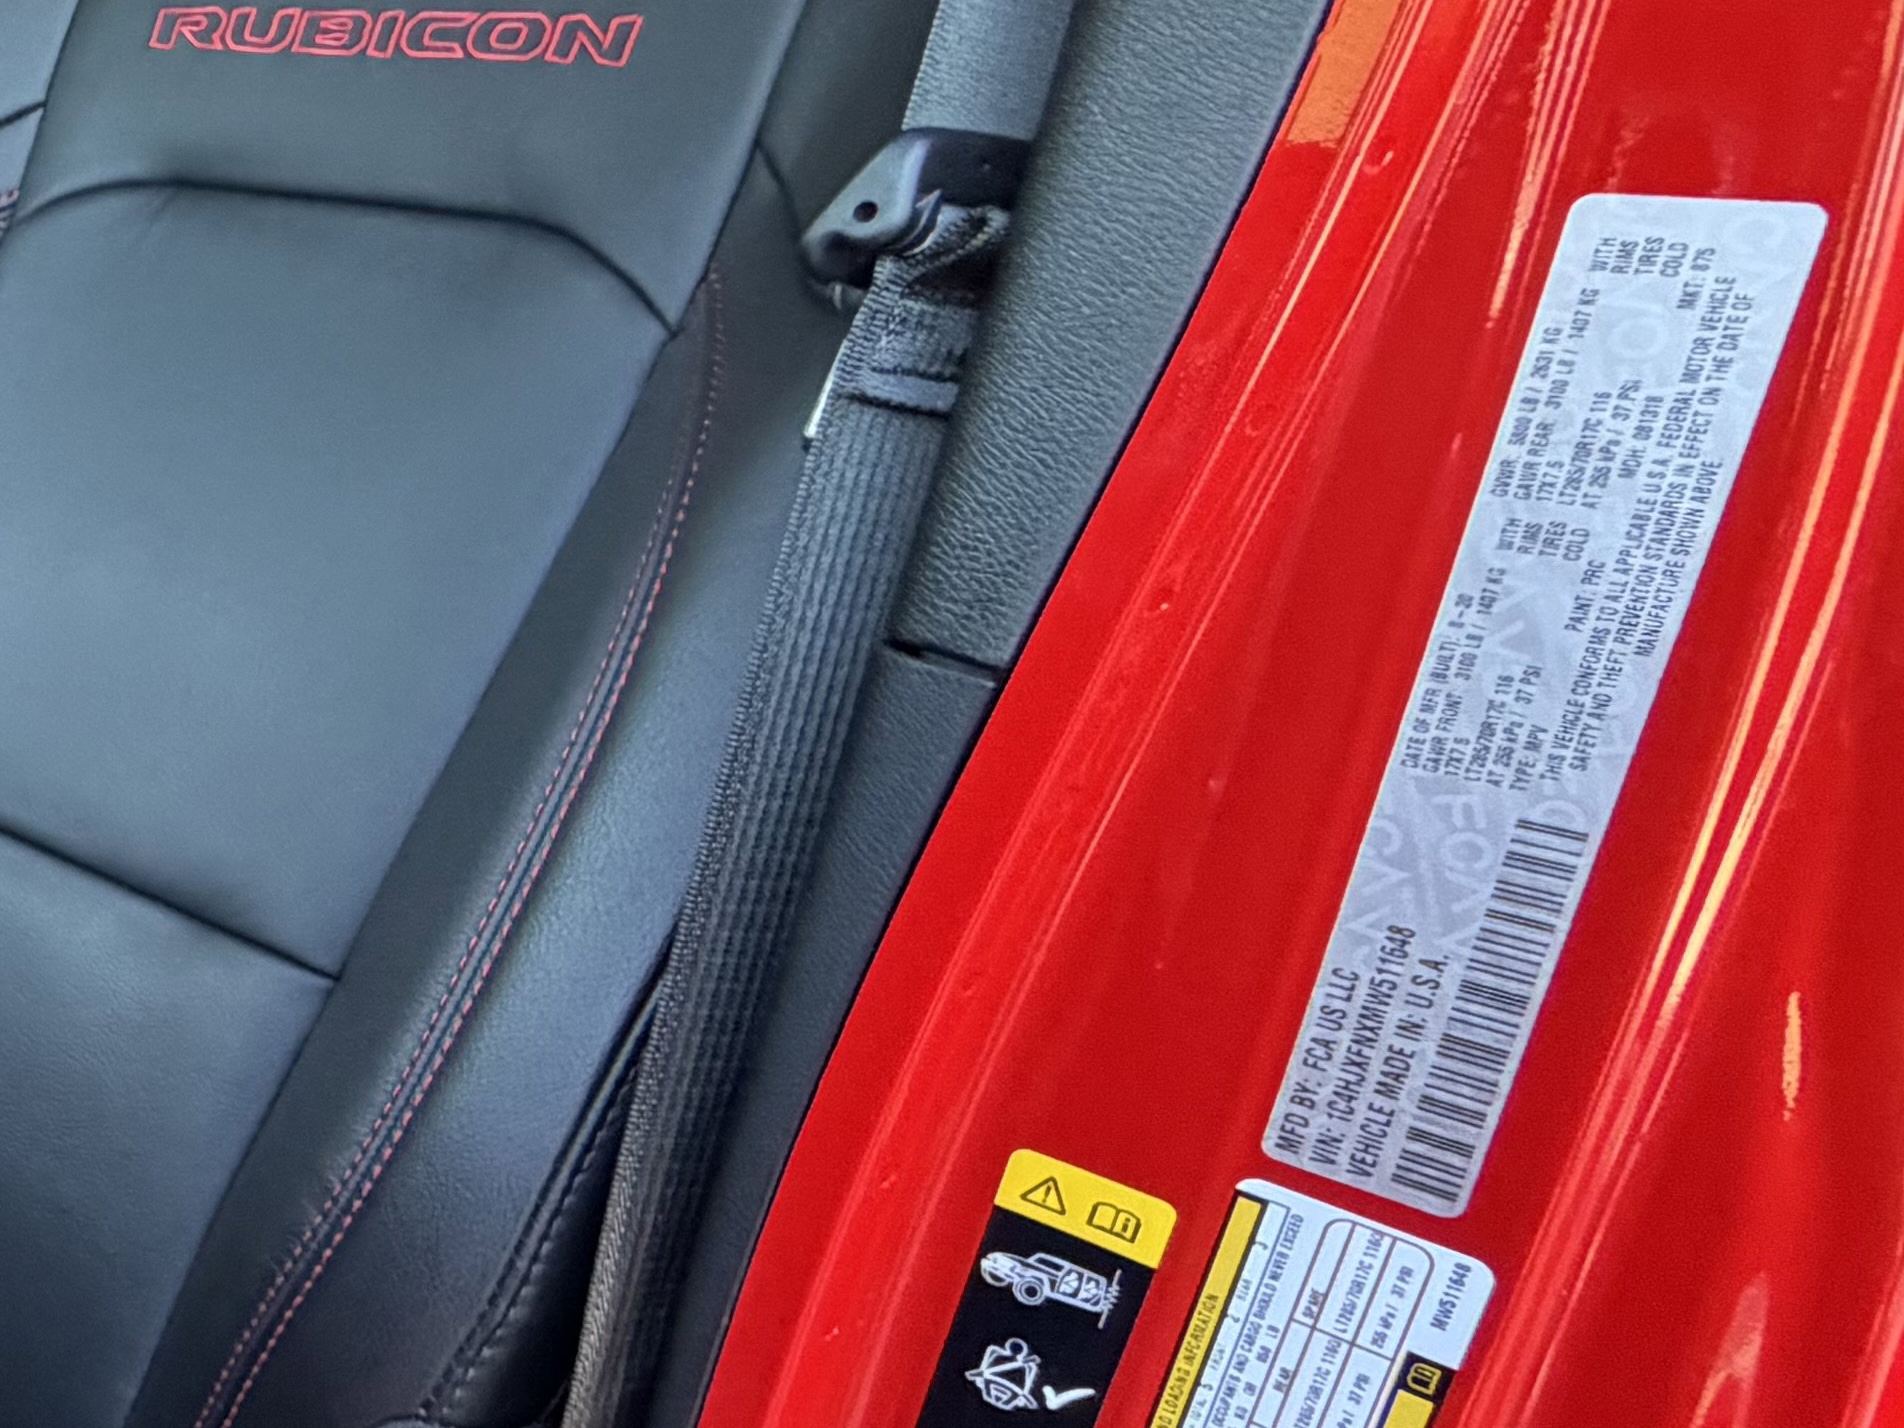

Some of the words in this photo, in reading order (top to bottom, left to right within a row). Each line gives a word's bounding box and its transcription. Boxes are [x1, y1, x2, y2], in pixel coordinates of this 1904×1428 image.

[149, 6, 644, 68] RUBICON
[1587, 236, 1617, 272] WITH
[1609, 239, 1639, 274] RIMS
[1633, 236, 1665, 275] TIRES
[1658, 241, 1689, 278] COLD
[1576, 287, 1600, 306] KG
[1697, 276, 1737, 332] VEHICLE
[1730, 292, 1758, 311] OF
[1716, 316, 1749, 351] DATE
[1517, 396, 1540, 412] LB
[1539, 326, 1563, 344] KG
[1553, 357, 1577, 375] LB
[1679, 336, 1716, 384] MOTOR
[1705, 355, 1735, 382] THE
[1616, 378, 1642, 401] PSI
[1697, 386, 1724, 405] ON
[1609, 404, 1633, 421] 37
[1656, 387, 1698, 449] FEDERAL
[1678, 410, 1715, 459] EFFECT
[1513, 459, 1543, 500] GAWR
[1671, 462, 1696, 477] IN
[1579, 491, 1603, 509] AT
[1516, 521, 1544, 555] RIMS
[1539, 520, 1568, 557] TIRES
[1611, 497, 1658, 577] APPLICABLE
[1641, 481, 1689, 561] STANDARDS
[1562, 527, 1590, 562] COLD
[1579, 558, 1607, 586] PRC
[1632, 558, 1687, 657] MANUFACTURE
[1668, 507, 1706, 556] SHOWN
[1602, 578, 1630, 603] ALL
[1611, 564, 1659, 645] PREVENTION
[1594, 605, 1620, 624] TO
[1421, 731, 1451, 773] GAWR
[1483, 566, 1506, 584] KG
[1495, 517, 1523, 551] WITH
[1569, 626, 1613, 697] CONFORMS
[1519, 663, 1543, 686] PSI
[1596, 650, 1628, 690] THEFT
[1418, 687, 1443, 715] MFR
[1512, 688, 1534, 705] 37
[1585, 691, 1613, 720] AND
[1412, 717, 1434, 734] OF
[1522, 723, 1549, 753] MPV
[1550, 698, 1587, 750] VEHICLE
[1401, 736, 1427, 769] DATE
[1491, 744, 1515, 768] 255
[1567, 723, 1602, 772] SAFETY
[1484, 770, 1506, 788] AT
[1539, 752, 1568, 782] THIS
[1322, 966, 1360, 1002] LLC
[1402, 948, 1450, 1010] U.S.A.
[1313, 1003, 1347, 1033] US
[1322, 922, 1416, 1125] 1C4HJXFNXMW511648
[1392, 1011, 1428, 1042] IN:
[1300, 1034, 1337, 1072] FCA
[1372, 1043, 1417, 1101] MADE
[1288, 1075, 1324, 1110] BY:
[1274, 1110, 1312, 1155] MFD
[1308, 1125, 1348, 1168] VIN:
[1345, 1101, 1397, 1180] VEHICLE
[1162, 1366, 1191, 1415] LOADING
[1180, 1291, 1219, 1366] INFORMATION
